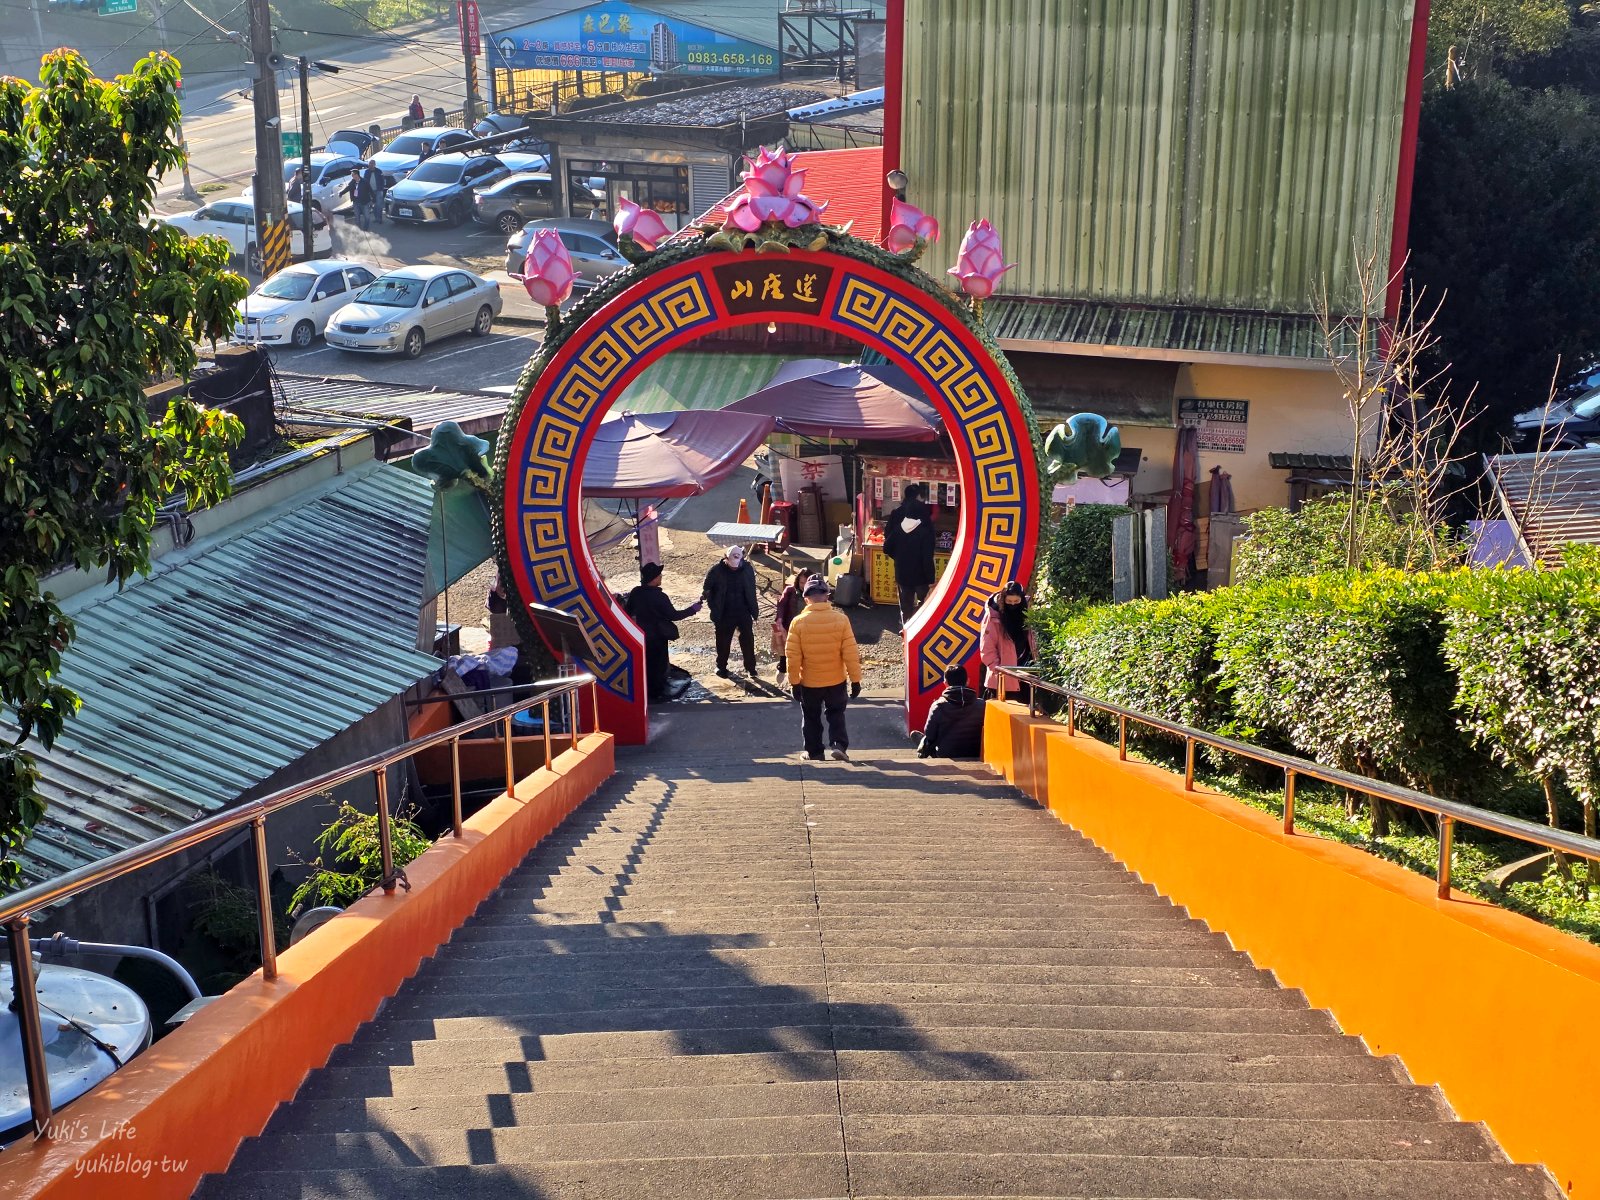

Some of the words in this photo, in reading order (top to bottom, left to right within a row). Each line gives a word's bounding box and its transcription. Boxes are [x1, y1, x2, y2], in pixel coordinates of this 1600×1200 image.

[688, 52, 773, 65] 0983-658-168
[1197, 400, 1245, 410] 有巢氏房屋
